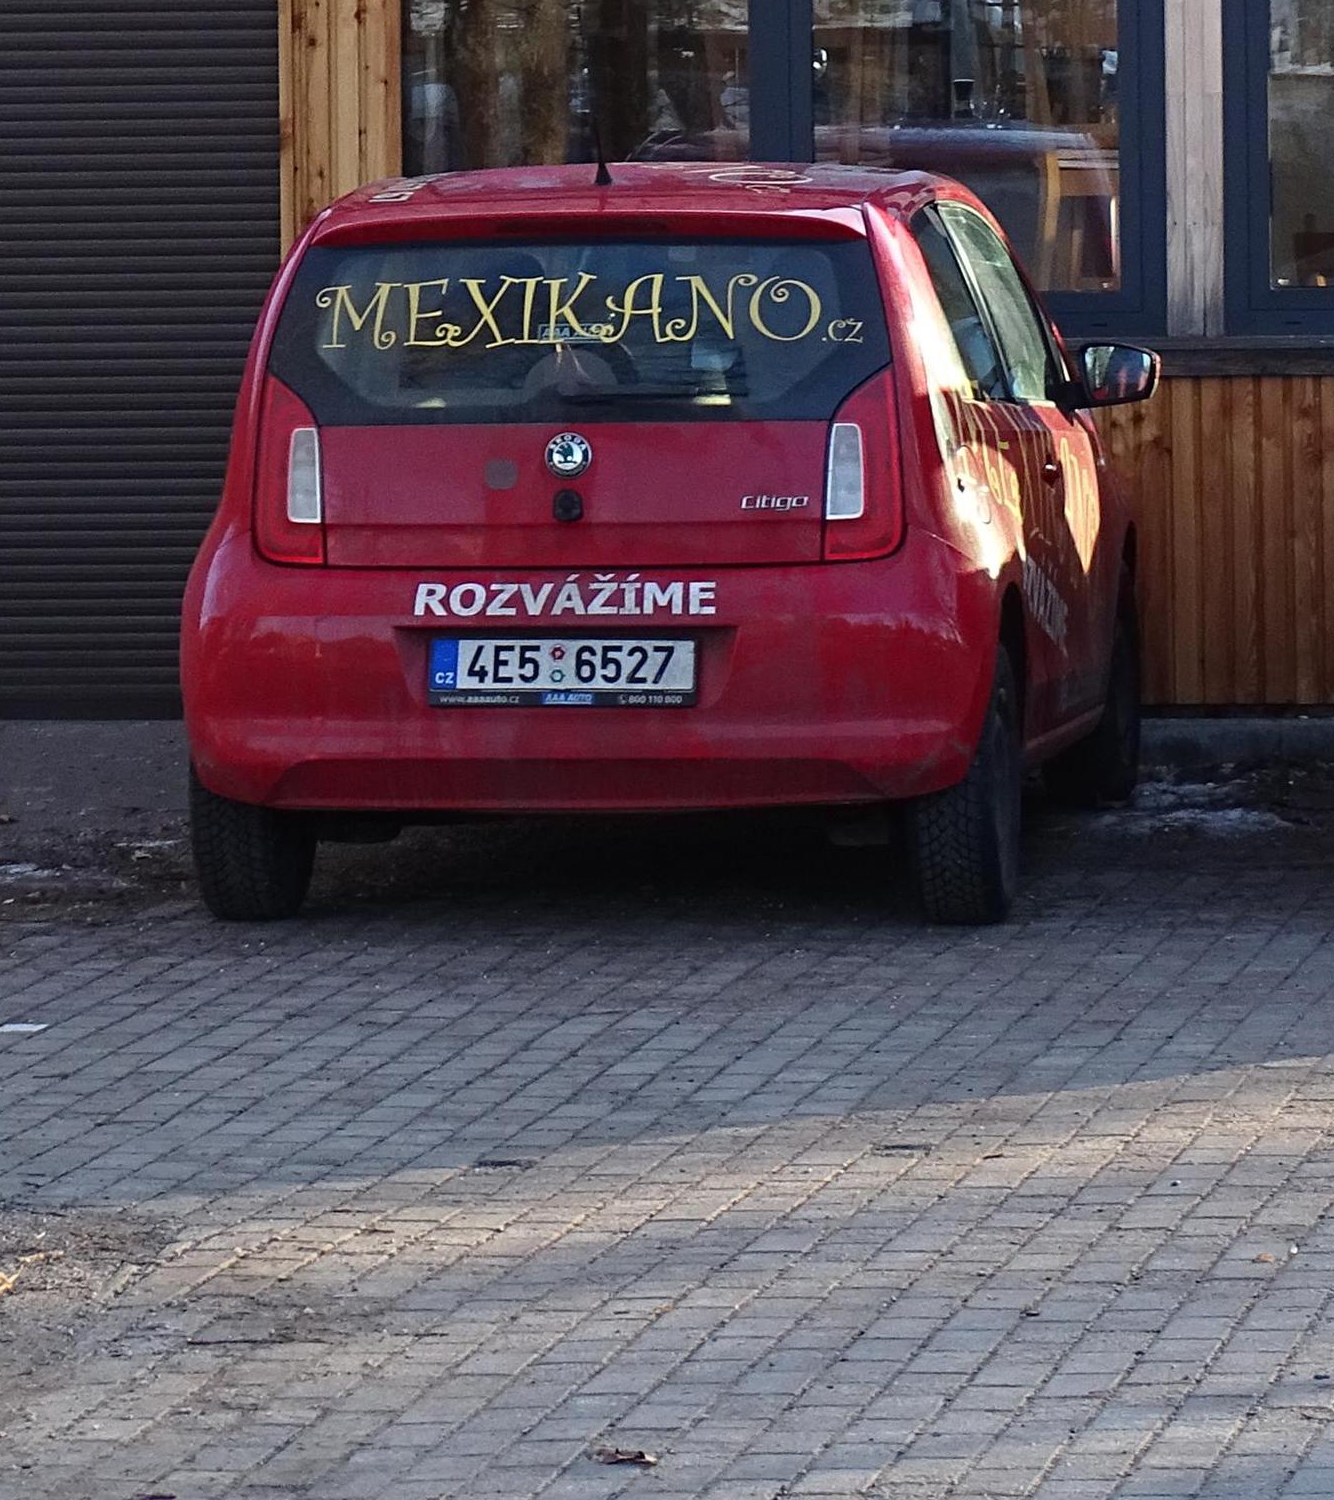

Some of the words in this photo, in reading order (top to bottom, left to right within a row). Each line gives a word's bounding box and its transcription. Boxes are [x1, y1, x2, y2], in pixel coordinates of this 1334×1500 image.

[413, 573, 716, 616] ROZVÁŽÍME
[435, 672, 454, 685] CZ
[467, 645, 541, 684] 4E5
[575, 645, 675, 684] 6527
